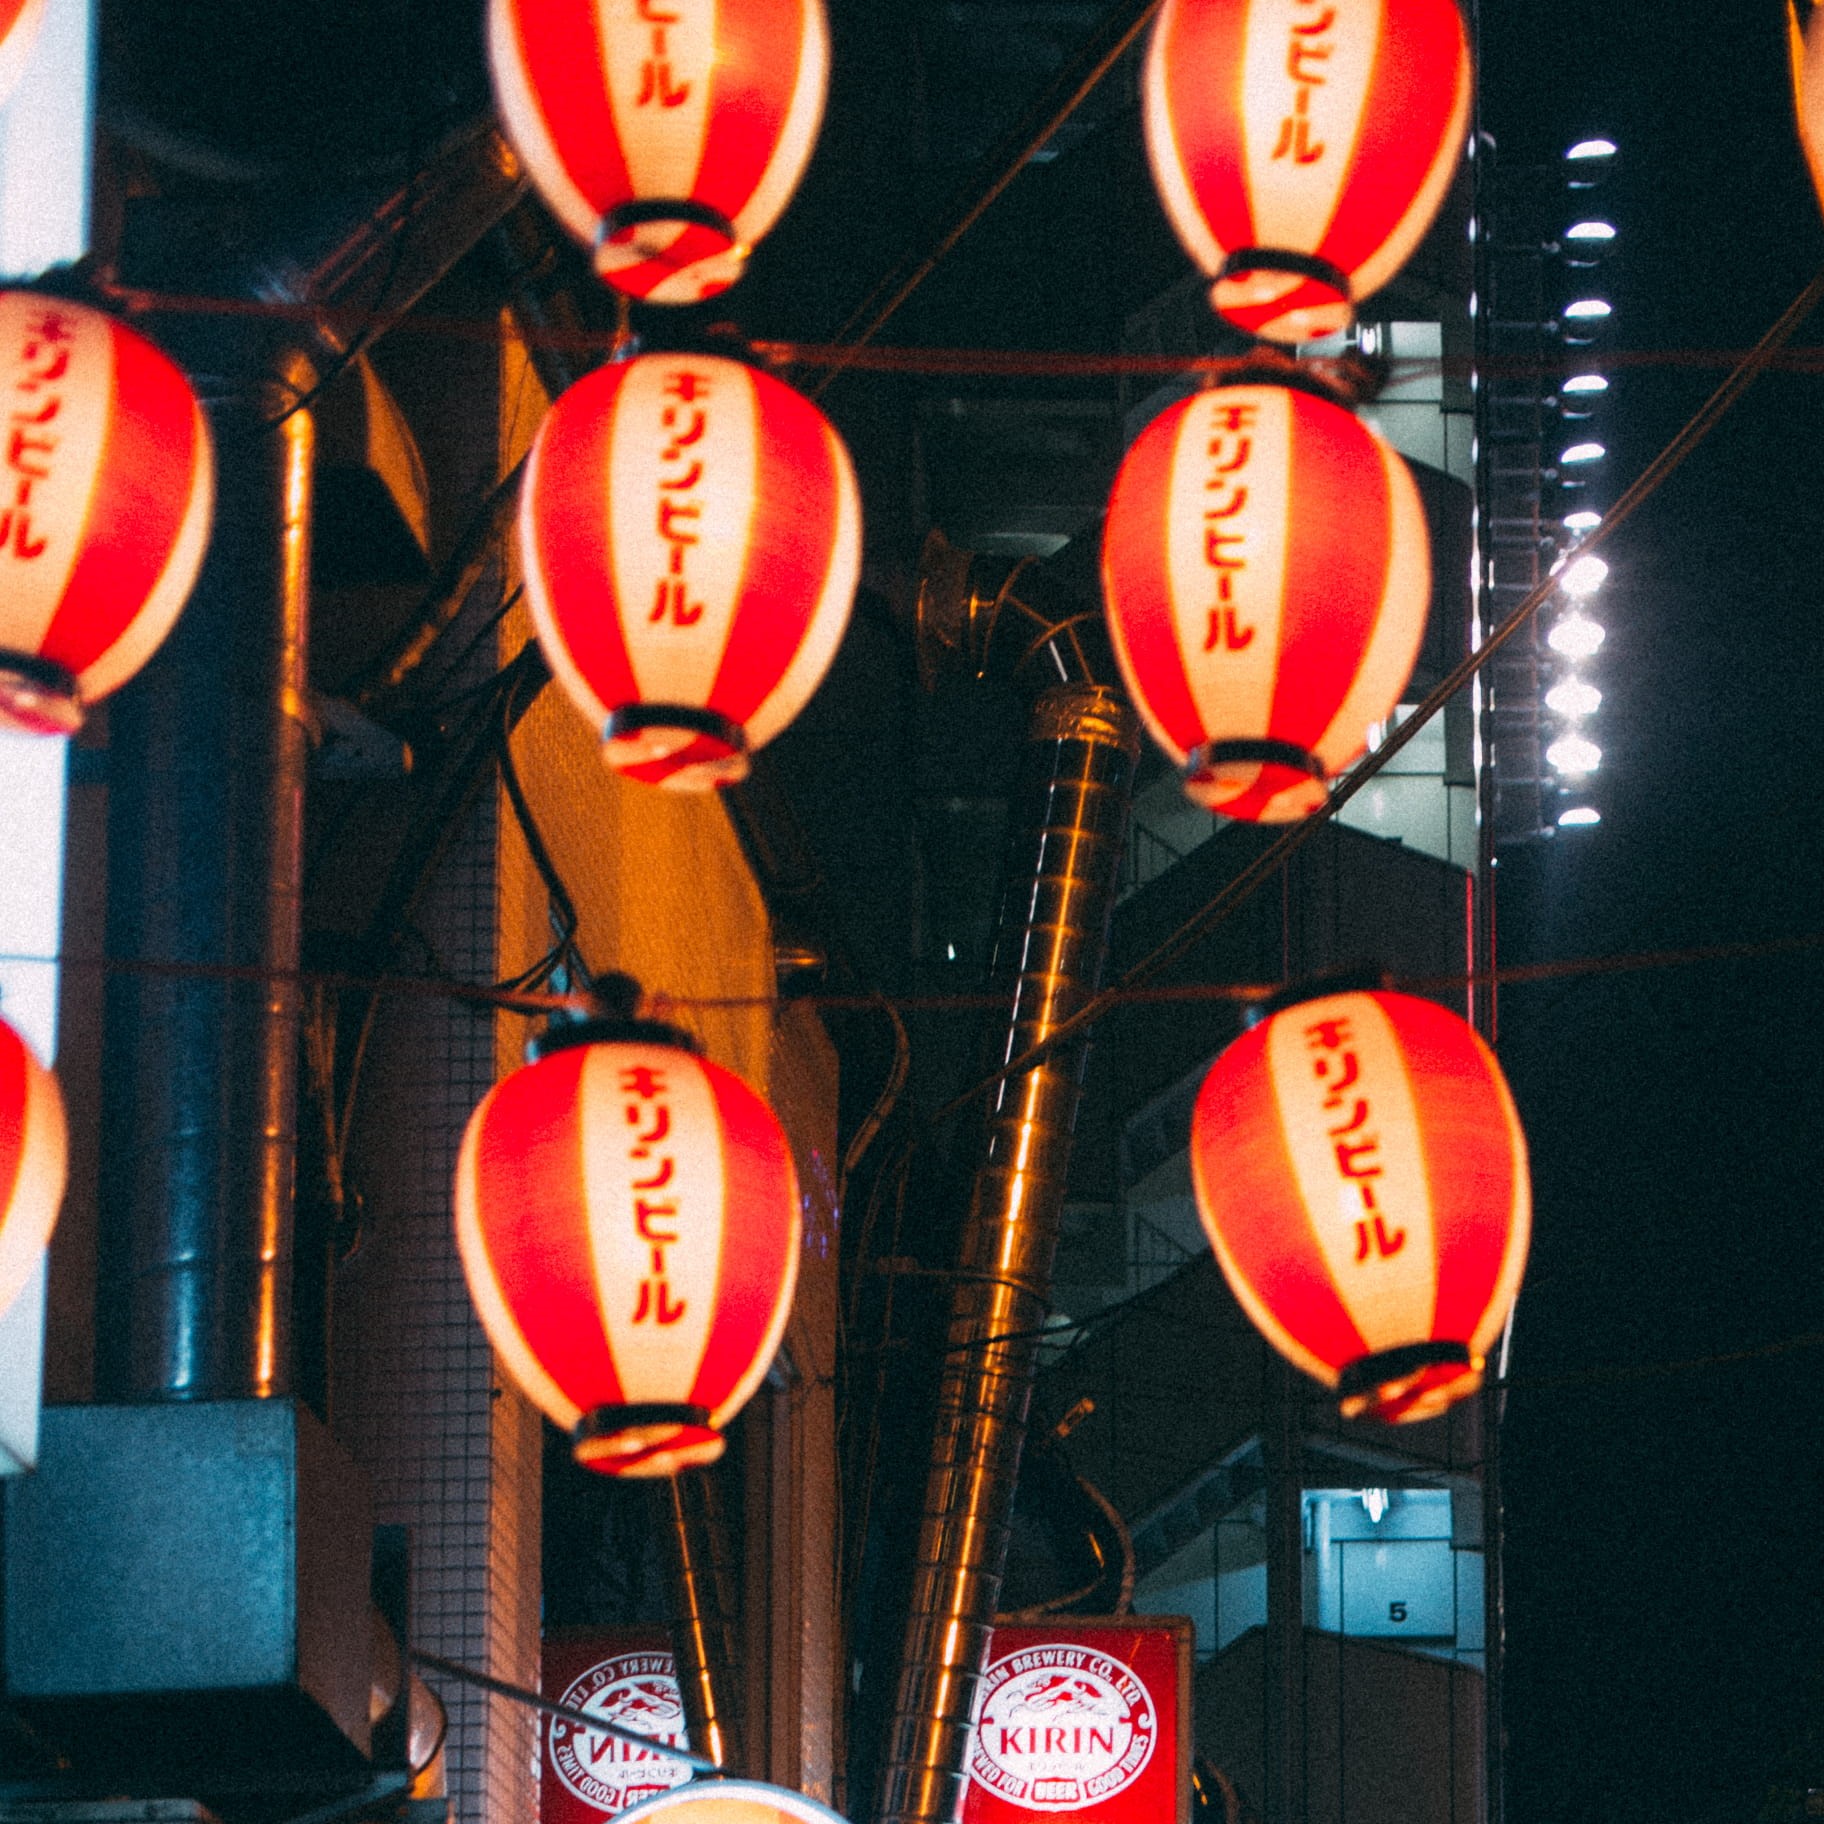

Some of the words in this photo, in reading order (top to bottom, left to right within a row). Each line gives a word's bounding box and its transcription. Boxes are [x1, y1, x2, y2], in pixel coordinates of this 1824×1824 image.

[648, 373, 705, 628] キリンビール
[1204, 404, 1259, 653] キリンビール
[1304, 1018, 1405, 1263] キリンビール
[620, 1066, 686, 1326] キリンビール
[1389, 1604, 1408, 1621] 5
[1012, 1650, 1087, 1675] BREWERY
[999, 1727, 1115, 1755] KIRIN
[1034, 1780, 1079, 1801] BEER
[1085, 1766, 1126, 1798] GOOD
